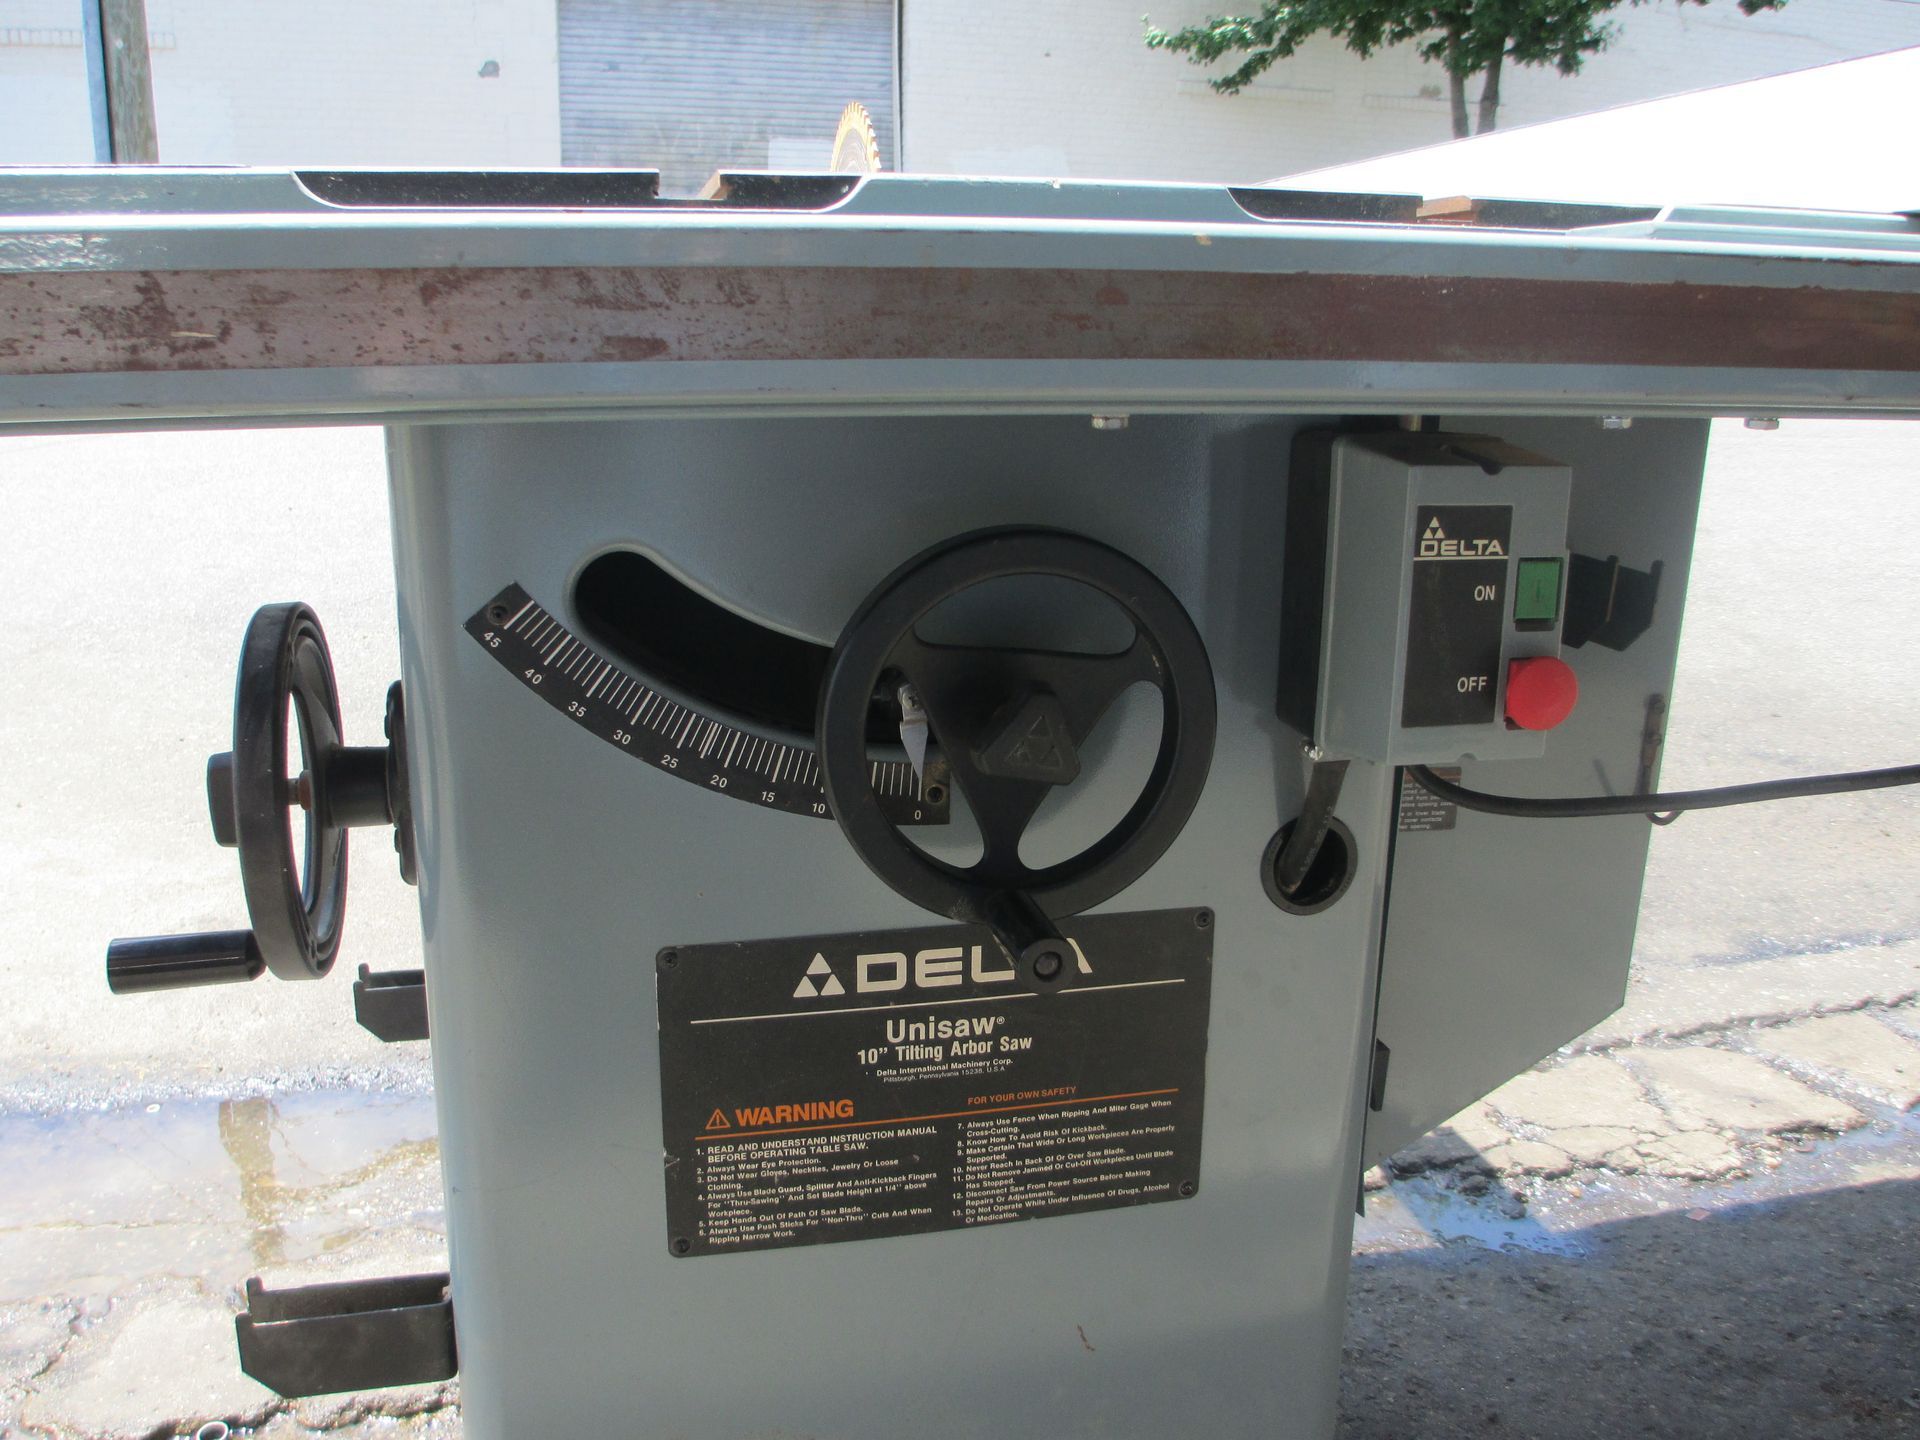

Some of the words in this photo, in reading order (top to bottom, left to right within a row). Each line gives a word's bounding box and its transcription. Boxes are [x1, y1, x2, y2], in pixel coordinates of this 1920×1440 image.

[1420, 539, 1503, 557] DELTA
[1474, 585, 1495, 601] ON
[1457, 676, 1488, 693] OFF
[483, 631, 501, 648] 45
[524, 668, 542, 685] 40
[568, 701, 585, 718] 35
[613, 730, 631, 745] 30
[661, 754, 678, 770] 25
[710, 774, 728, 789] 20
[760, 791, 775, 803] 15
[812, 802, 825, 815] 10
[915, 810, 921, 821] 0
[856, 937, 1092, 993] DEL
[895, 1044, 942, 1061] Tilting
[950, 1039, 992, 1056] Arbor
[999, 1036, 1032, 1051] Saw
[899, 1063, 948, 1074] International
[950, 1060, 990, 1069] Machinery
[919, 1071, 959, 1079] Pennsylvania
[968, 1096, 986, 1104] FOR
[989, 1093, 1014, 1101] YOUR
[1017, 1091, 1039, 1099] OWN
[1041, 1086, 1075, 1096] SAFETY
[735, 1099, 853, 1126] WARNING
[967, 1120, 993, 1128] Always
[1061, 1109, 1089, 1118] Ripping
[707, 1145, 734, 1154] READ
[737, 1142, 758, 1151] AND
[761, 1136, 827, 1149] UNDERSTAND
[830, 1130, 894, 1143] INSTRUCTION
[897, 1126, 936, 1136] MANUAL
[1020, 1131, 1040, 1139] Avoid
[707, 1152, 746, 1163] BEFORE
[750, 1147, 806, 1159] OPERATING
[810, 1144, 840, 1153] TABLE
[843, 1142, 868, 1151] SAW.
[987, 1143, 1014, 1152] Certain
[707, 1165, 735, 1173] Always
[778, 1157, 821, 1166] Protection.
[831, 1162, 860, 1171] Jewelry
[990, 1160, 1013, 1168] Reach
[1025, 1157, 1042, 1165] Back
[991, 1169, 1020, 1177] Remove
[1022, 1164, 1052, 1174] Jammed
[707, 1182, 743, 1191] Clothing.
[806, 1183, 834, 1191] Splitter
[853, 1175, 906, 1186] Anti-Kickback
[908, 1172, 936, 1180] Fingers
[965, 1187, 1007, 1197] Disconnect
[1072, 1176, 1097, 1184] Source
[1099, 1173, 1123, 1181] Before
[822, 1190, 844, 1198] Blade
[846, 1187, 871, 1195] Height
[965, 1198, 993, 1206] Repairs
[993, 1202, 1022, 1211] Operate
[1024, 1199, 1045, 1207] While
[1047, 1196, 1069, 1204] Under
[757, 1222, 777, 1230] Push
[779, 1220, 803, 1228] Sticks
[709, 1235, 739, 1244] Ripping
